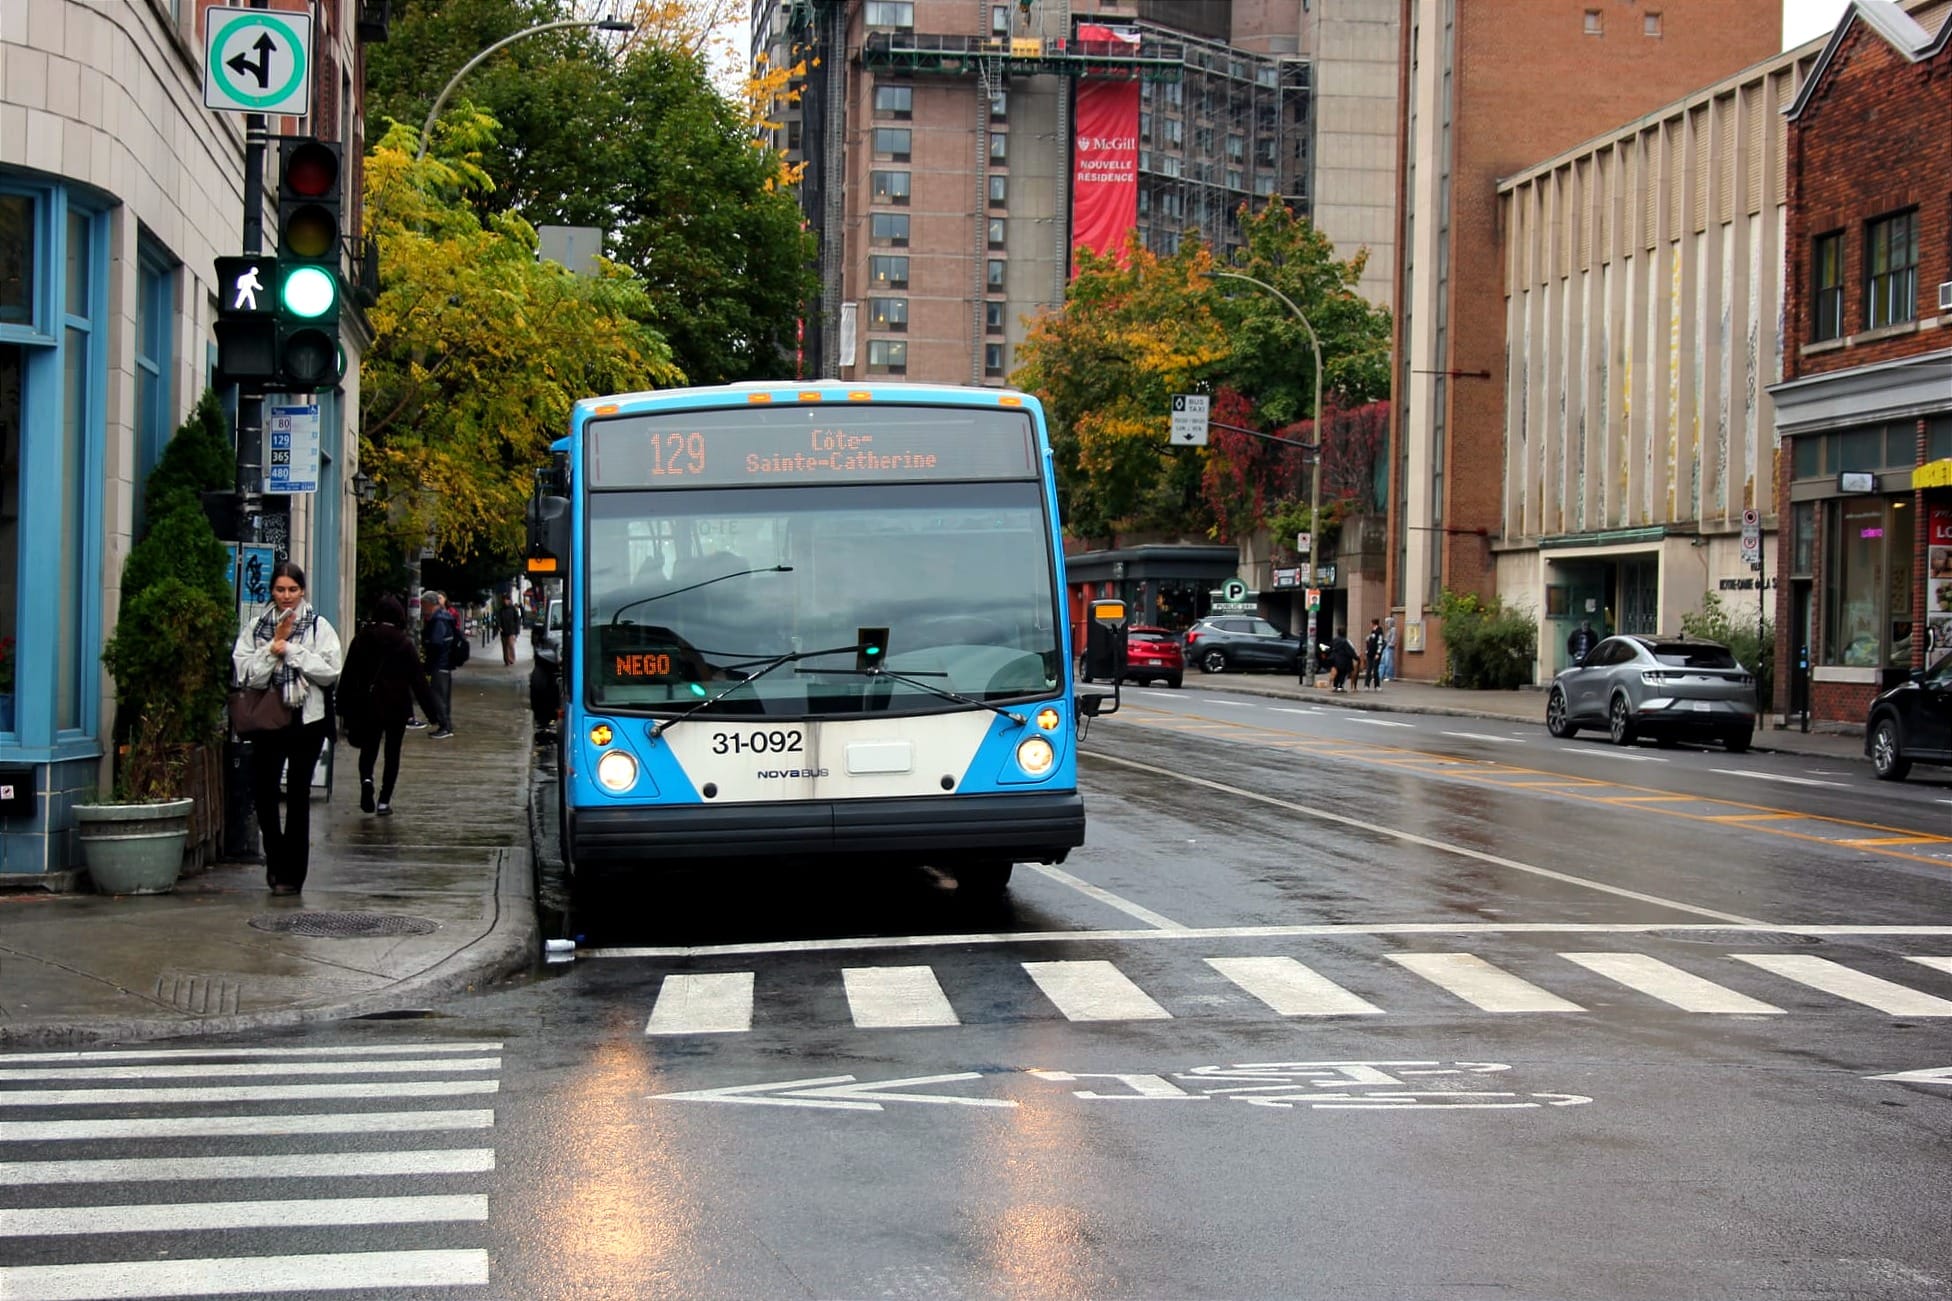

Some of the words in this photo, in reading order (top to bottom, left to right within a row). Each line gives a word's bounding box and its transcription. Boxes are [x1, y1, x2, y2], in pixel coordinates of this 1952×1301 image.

[1093, 137, 1135, 151] McGill
[1080, 160, 1132, 169] NOUVELLE
[278, 418, 290, 429] 80
[272, 434, 290, 446] 129
[810, 428, 873, 451] Côte-
[272, 451, 289, 463] 365
[650, 431, 706, 476] 129
[745, 451, 937, 473] Sainte-Catherine
[271, 467, 289, 479] 480
[1230, 584, 1243, 599] P
[615, 653, 671, 677] NEGO
[712, 729, 804, 755] 31-092
